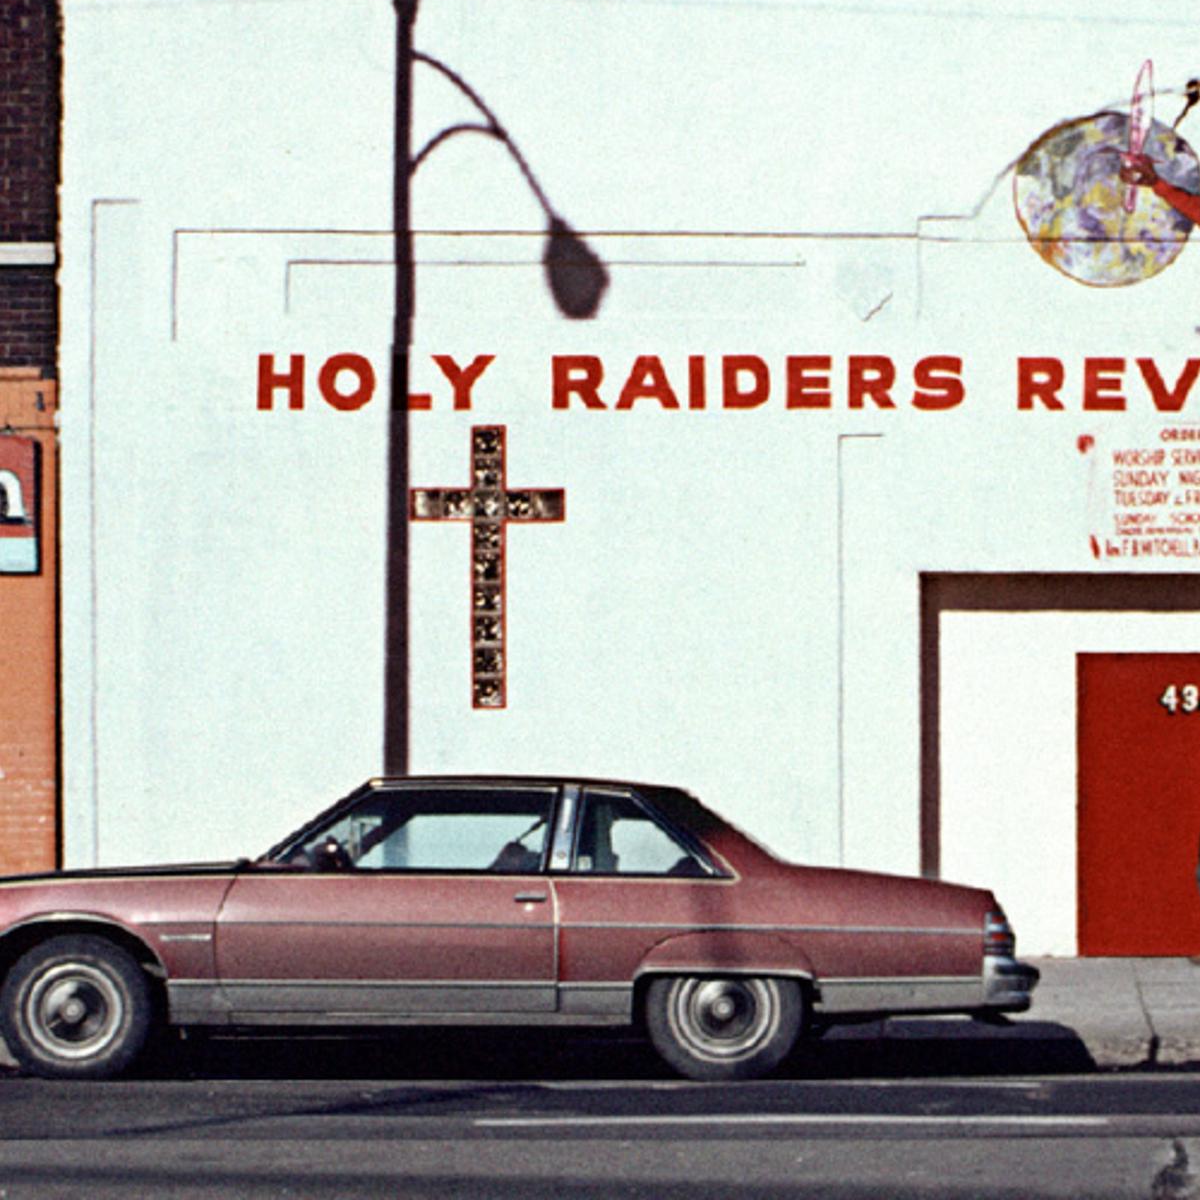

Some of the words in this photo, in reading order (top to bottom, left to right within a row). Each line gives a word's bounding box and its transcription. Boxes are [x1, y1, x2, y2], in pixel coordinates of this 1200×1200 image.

[256, 353, 496, 412] HOLY
[551, 354, 967, 412] RAIDERS
[1112, 449, 1165, 466] WORSHIP
[1113, 469, 1170, 487] SUNDAY
[1114, 489, 1170, 505] TUESDAY
